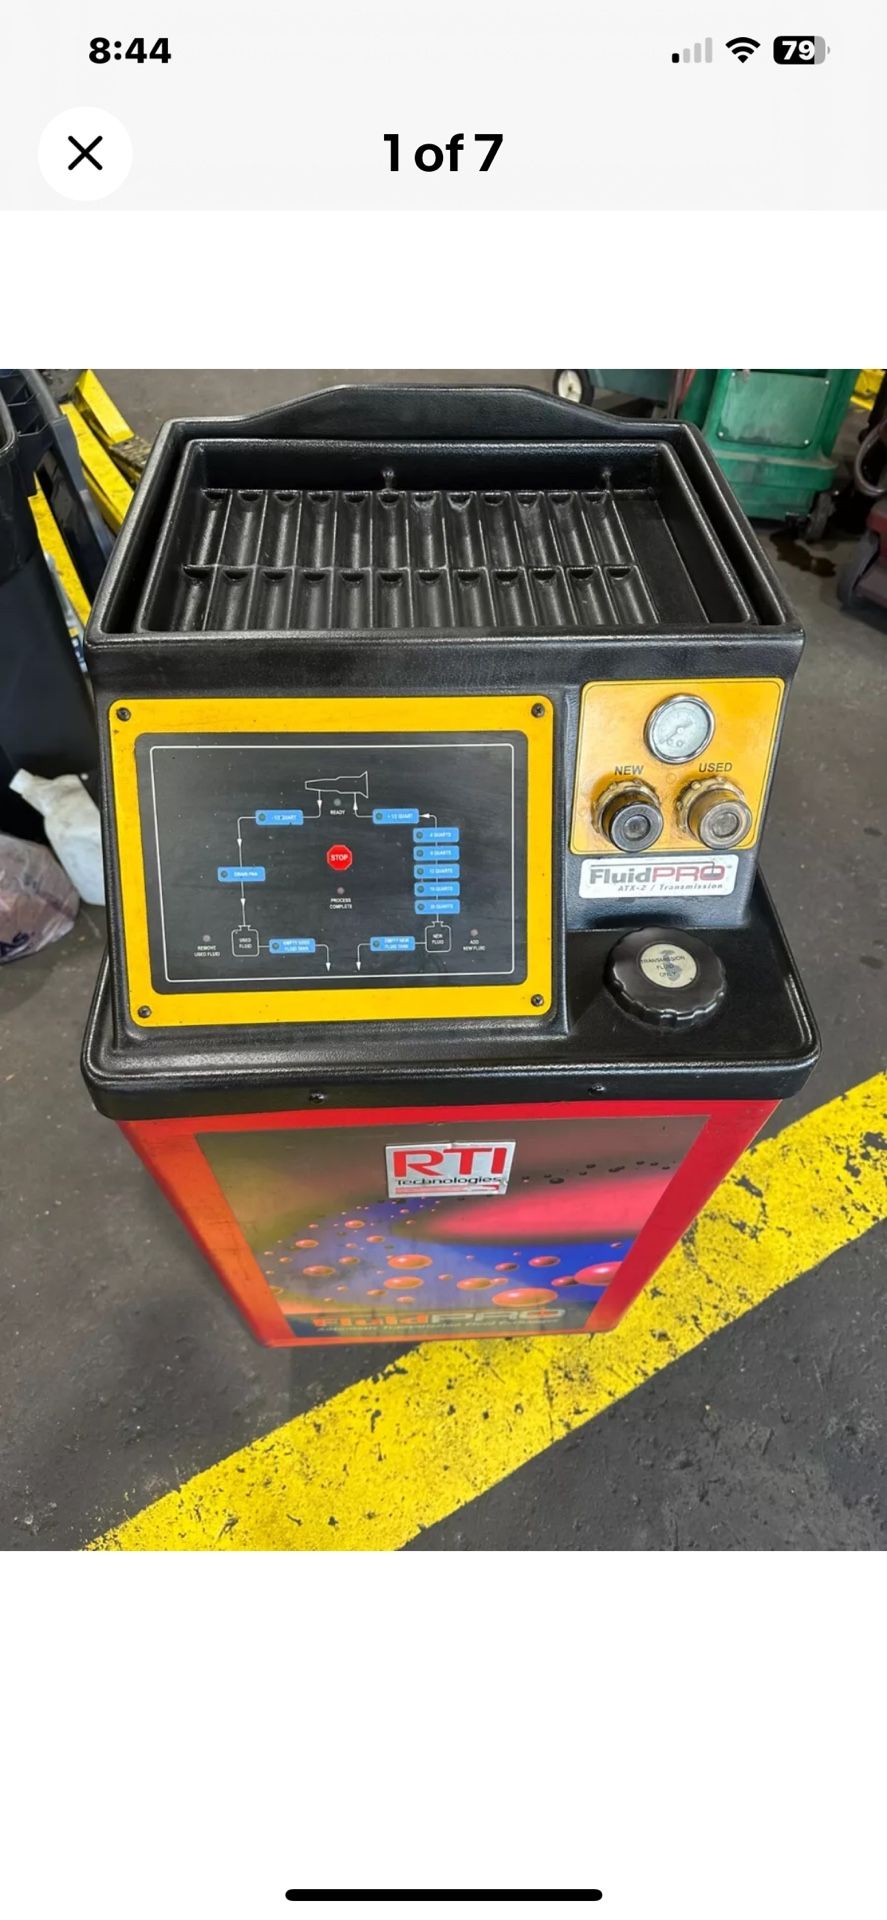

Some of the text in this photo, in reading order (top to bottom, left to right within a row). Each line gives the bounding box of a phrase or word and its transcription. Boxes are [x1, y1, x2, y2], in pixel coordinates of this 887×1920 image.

[614, 765, 644, 776] NEW
[698, 762, 733, 773] USED
[590, 865, 725, 884] FluidPRO
[659, 883, 723, 891] Transmission
[393, 1148, 507, 1177] RTI
